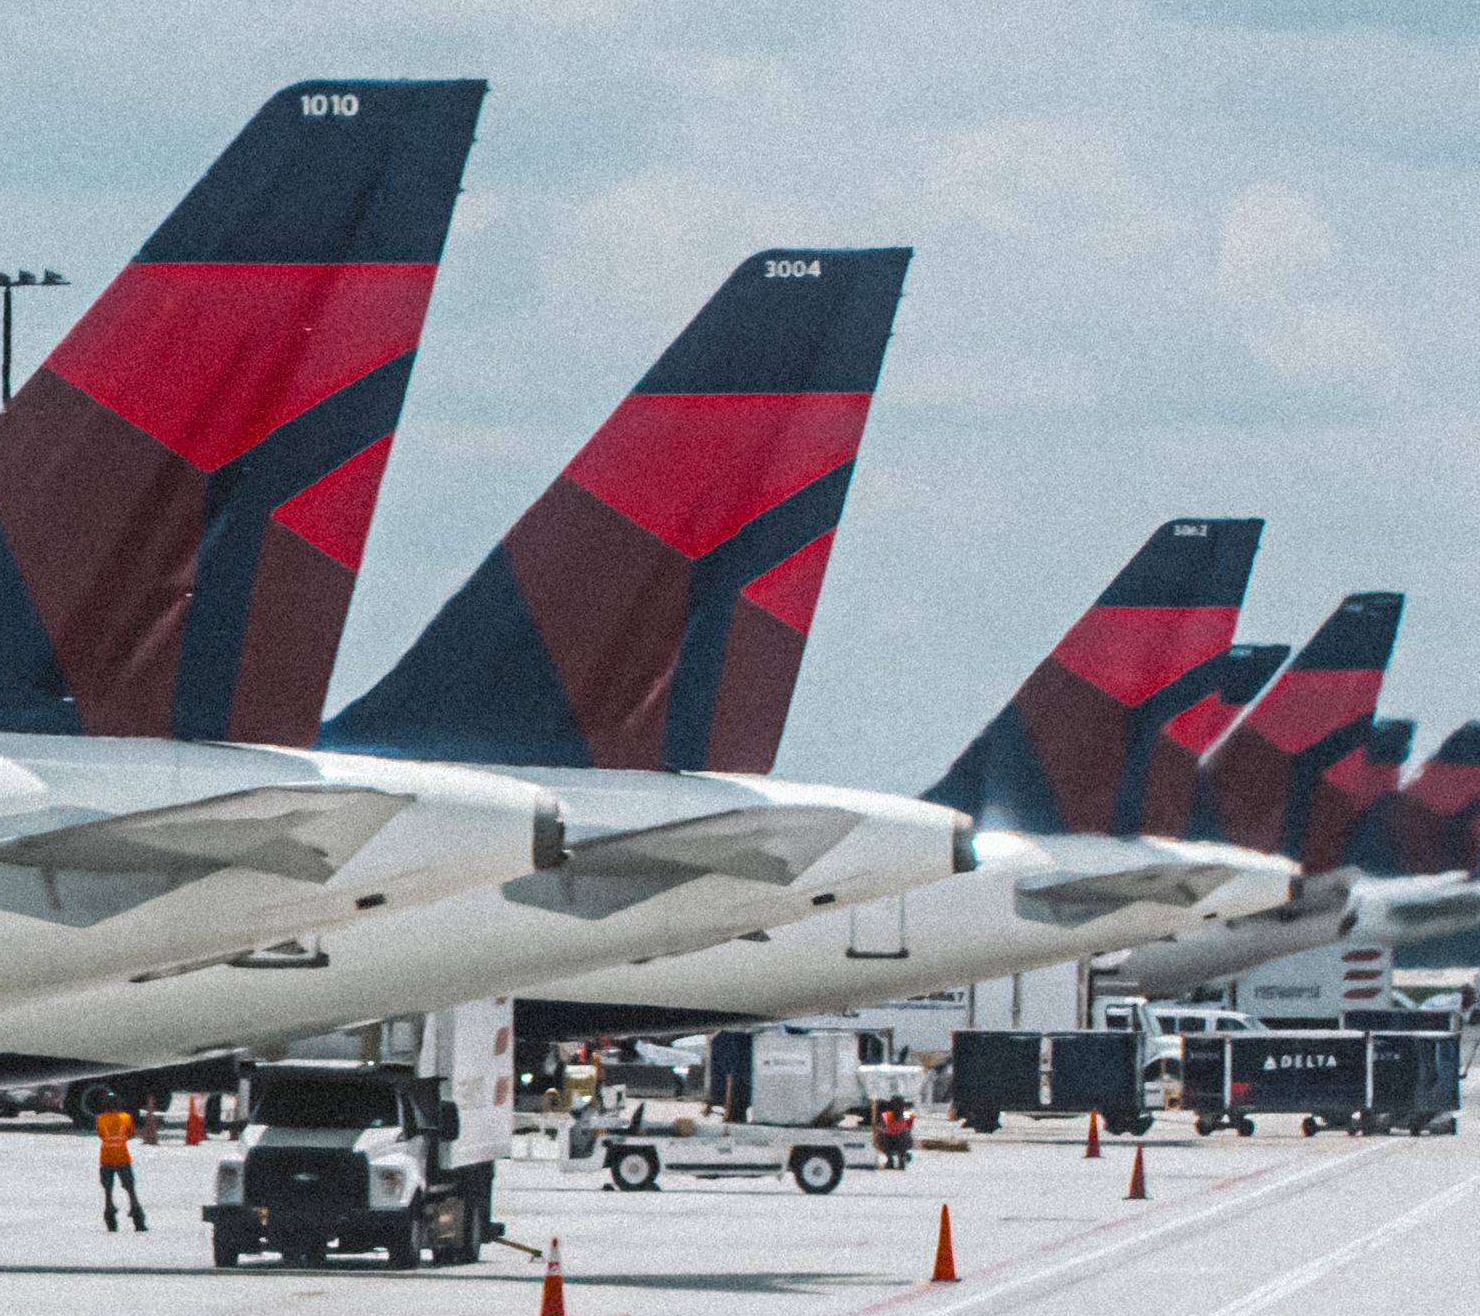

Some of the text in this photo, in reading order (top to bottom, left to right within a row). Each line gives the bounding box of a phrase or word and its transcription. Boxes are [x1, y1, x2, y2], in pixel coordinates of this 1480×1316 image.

[300, 94, 359, 116] 1010
[764, 259, 822, 279] 3004
[1279, 1053, 1338, 1069] DELTA
